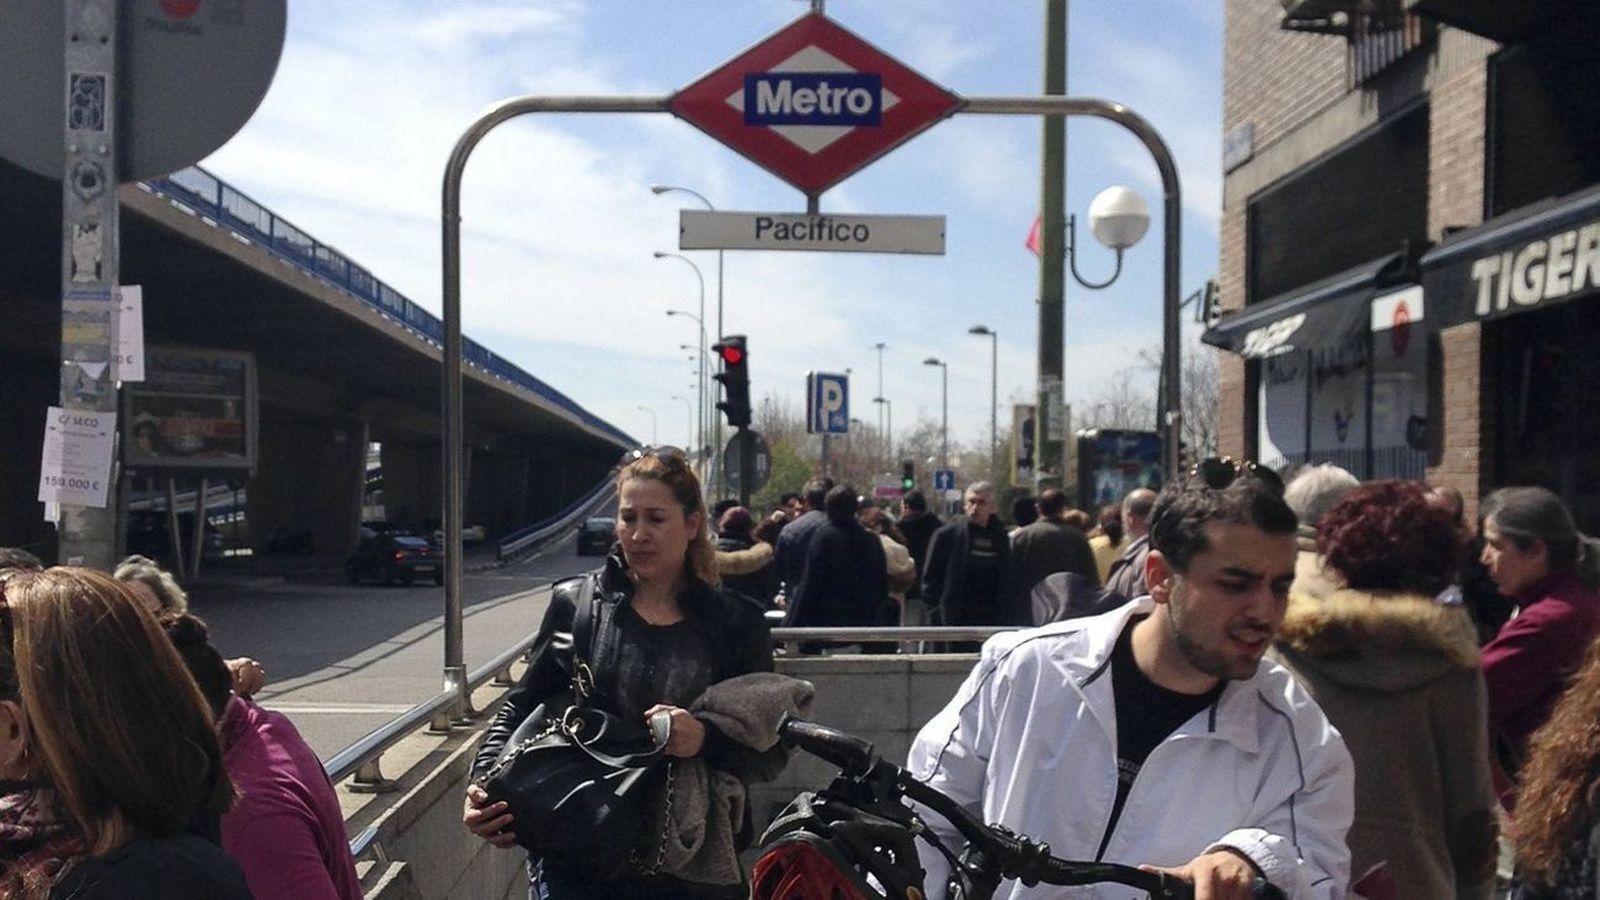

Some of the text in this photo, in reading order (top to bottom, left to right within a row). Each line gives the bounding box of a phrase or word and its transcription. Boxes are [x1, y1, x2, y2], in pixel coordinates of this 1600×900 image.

[756, 79, 873, 115] Metro
[1471, 221, 1600, 316] TIGER
[821, 380, 844, 432] P
